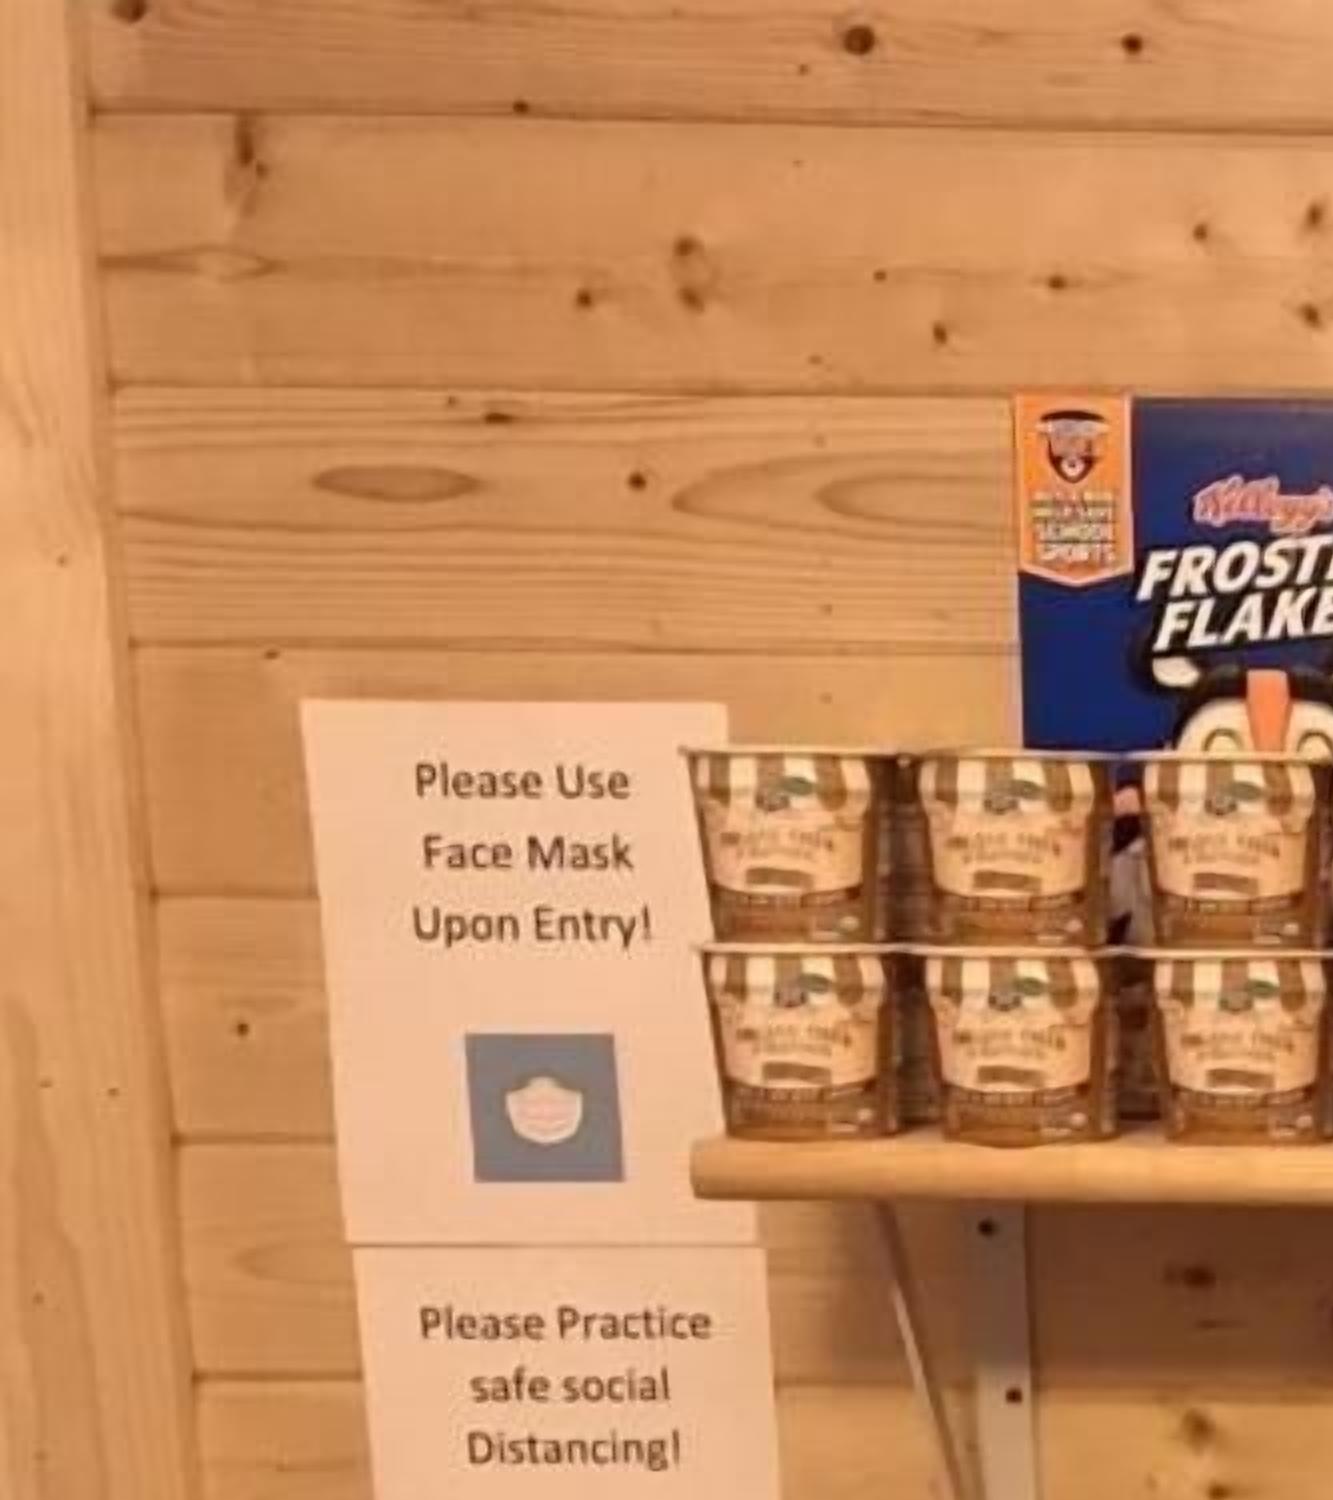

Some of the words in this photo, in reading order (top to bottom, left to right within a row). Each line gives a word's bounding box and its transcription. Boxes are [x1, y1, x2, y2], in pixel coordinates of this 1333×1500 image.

[415, 761, 543, 800] Please
[555, 763, 631, 800] Use
[423, 835, 513, 870] Face
[527, 835, 634, 870] Mask
[413, 906, 521, 948] Upon
[534, 906, 652, 949] Entry!
[420, 1305, 546, 1340] Please
[557, 1305, 712, 1340] Practice
[470, 1366, 552, 1404] safe
[563, 1366, 671, 1404] social
[467, 1431, 680, 1472] Distancing!
